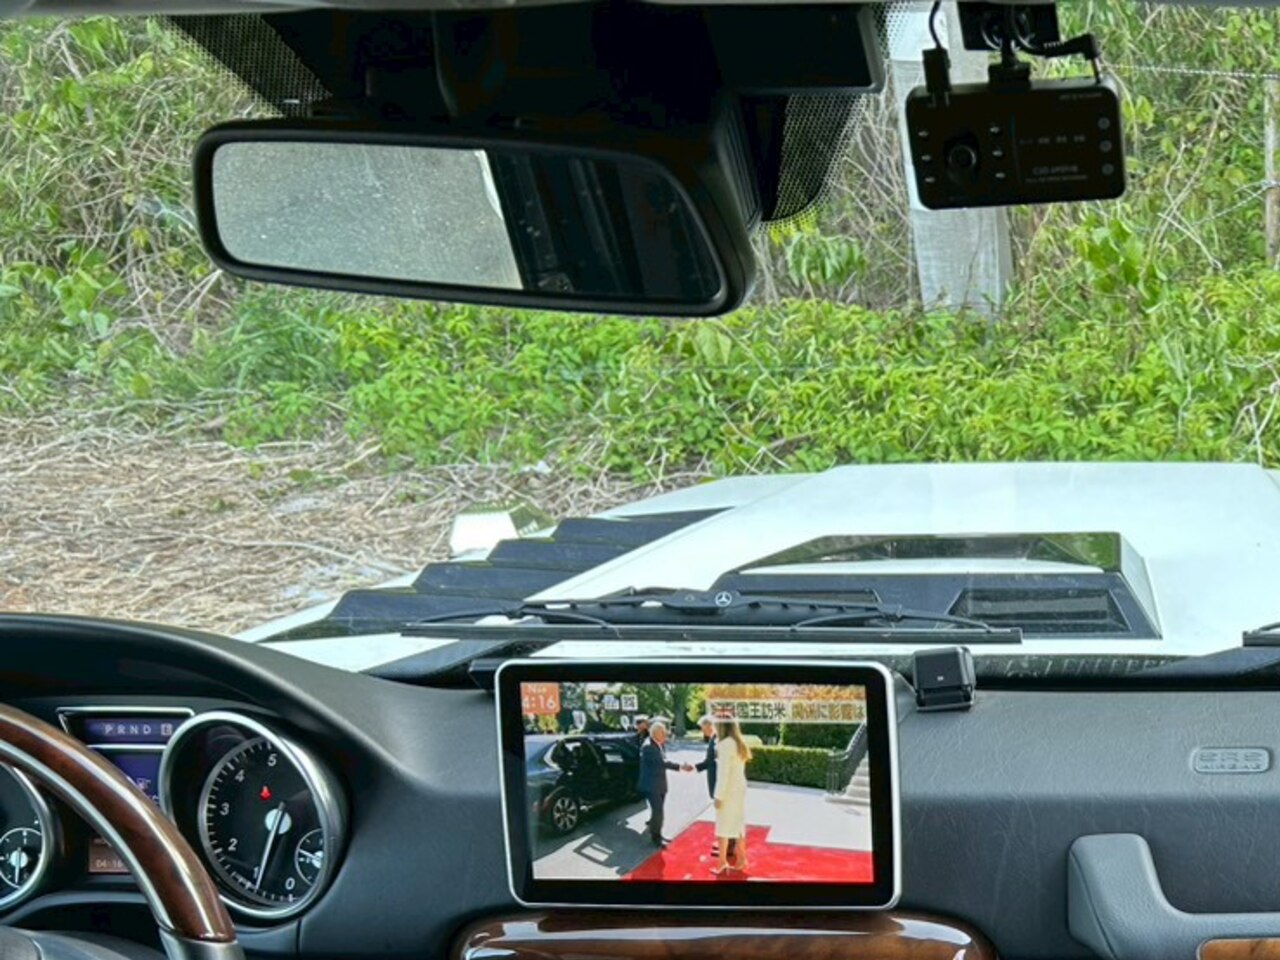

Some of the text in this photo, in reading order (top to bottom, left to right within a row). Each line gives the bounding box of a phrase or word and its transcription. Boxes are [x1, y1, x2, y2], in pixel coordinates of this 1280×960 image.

[116, 723, 126, 735] R
[129, 723, 139, 735] N
[142, 723, 152, 735] D
[267, 753, 278, 767] 5
[234, 769, 246, 783] 4
[219, 802, 231, 816] 3
[227, 837, 239, 852] 2
[284, 876, 296, 890] 0
